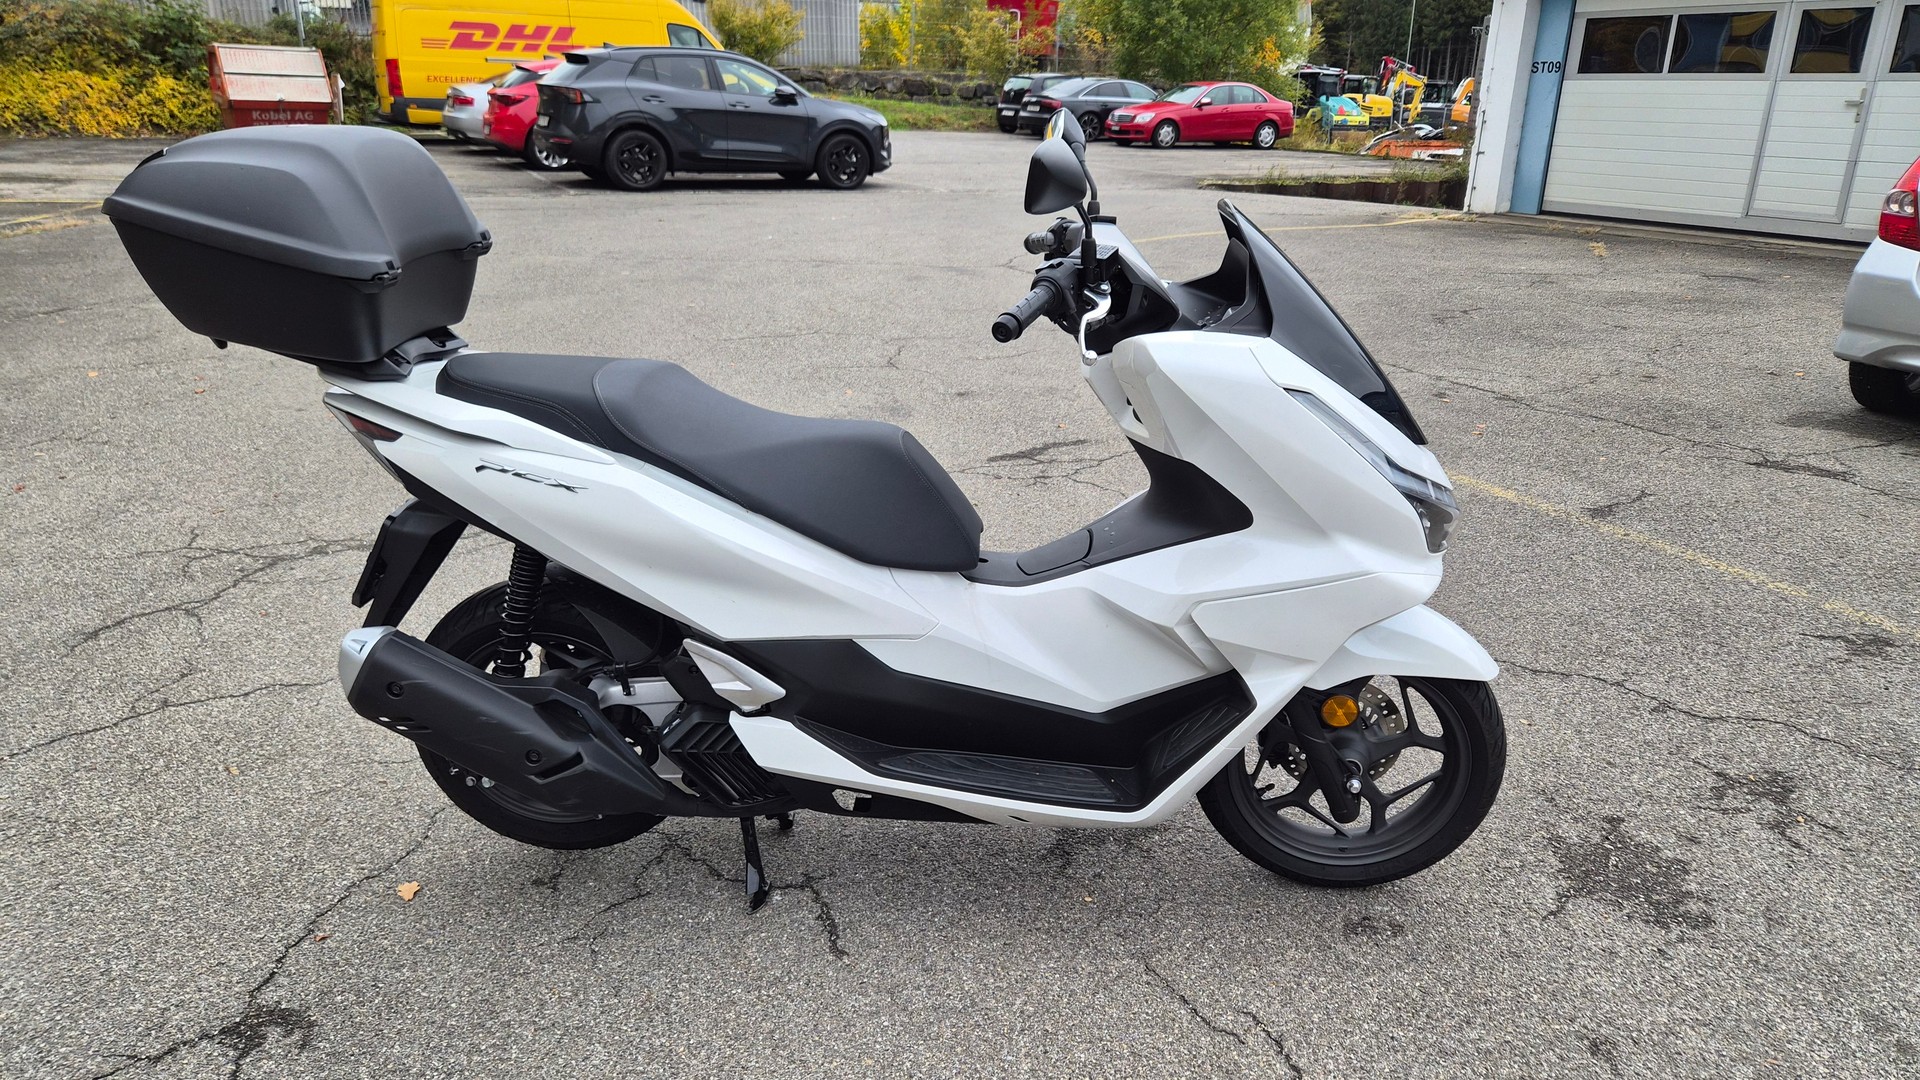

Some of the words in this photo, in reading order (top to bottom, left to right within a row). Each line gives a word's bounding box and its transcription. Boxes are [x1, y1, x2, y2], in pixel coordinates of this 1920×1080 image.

[449, 21, 585, 53] DHL
[1531, 61, 1561, 73] ST09
[295, 111, 314, 120] AG
[475, 458, 589, 493] PCX
